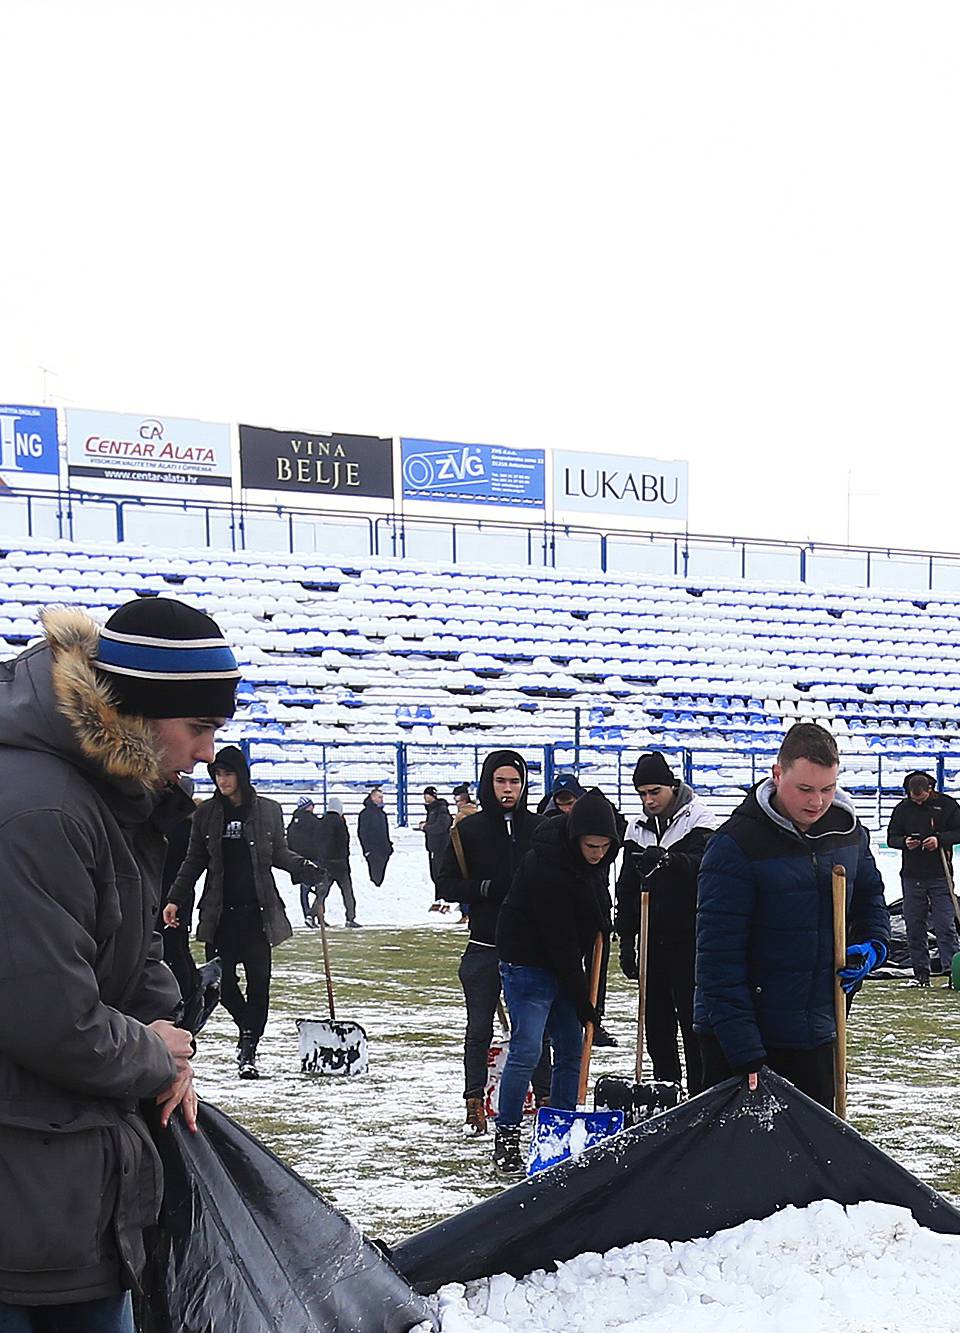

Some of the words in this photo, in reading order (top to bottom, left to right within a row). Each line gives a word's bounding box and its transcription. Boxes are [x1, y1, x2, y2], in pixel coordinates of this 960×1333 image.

[85, 436, 155, 457] CENTAR
[159, 442, 215, 462] ALATA
[291, 440, 345, 457] VINA
[104, 469, 198, 484] www.centar-alata.hr
[277, 457, 360, 489] BELJE
[436, 447, 485, 480] ZVG
[564, 467, 679, 504] LUKABU
